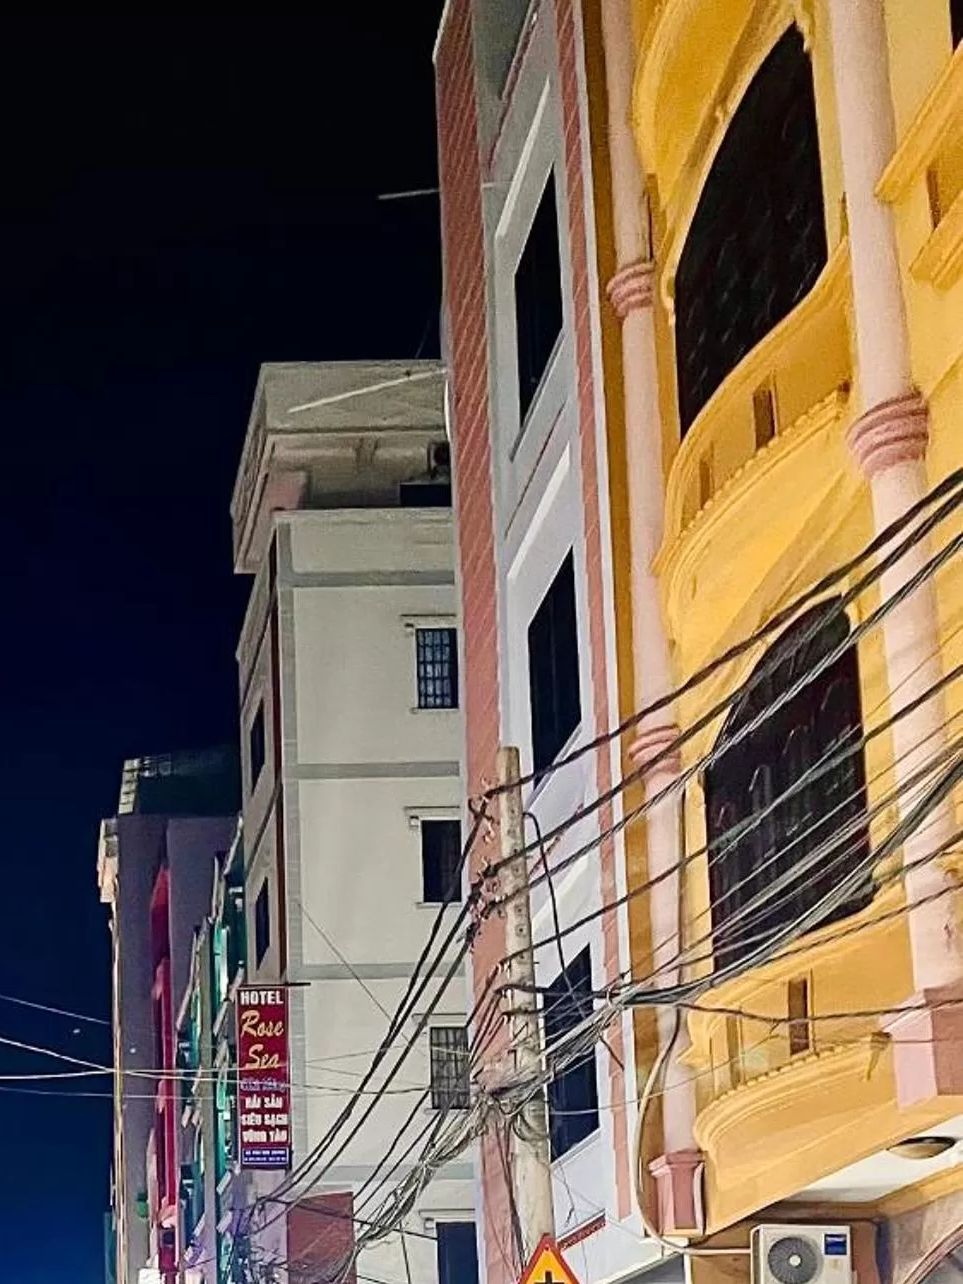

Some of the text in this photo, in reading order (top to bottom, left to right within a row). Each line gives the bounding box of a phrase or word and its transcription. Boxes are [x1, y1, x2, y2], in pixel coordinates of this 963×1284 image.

[240, 990, 284, 1006] HOTEL
[240, 1010, 284, 1038] Rose
[245, 1043, 281, 1069] Sea
